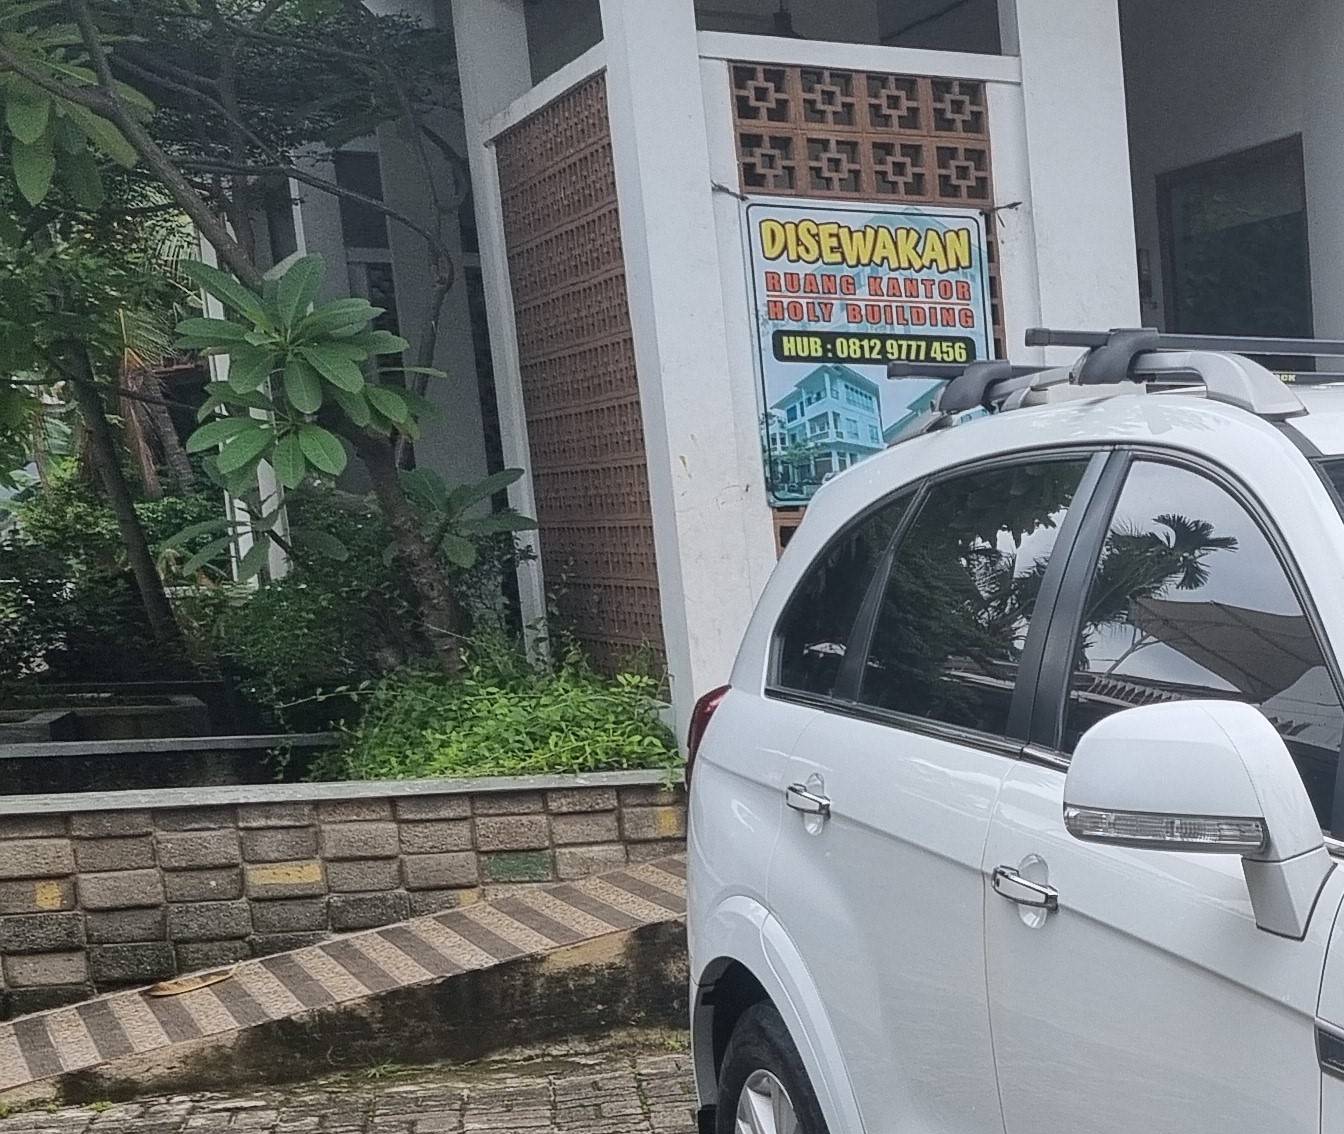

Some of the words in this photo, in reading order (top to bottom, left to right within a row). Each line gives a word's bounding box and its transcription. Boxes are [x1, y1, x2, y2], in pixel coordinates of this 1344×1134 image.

[759, 218, 973, 274] DISEWAKAN
[765, 271, 857, 296] RUANG
[867, 275, 972, 300] KANTOR
[767, 299, 834, 323] HOLY
[846, 303, 975, 329] BUILDING
[782, 335, 823, 358] HUB
[835, 337, 882, 360] 0812
[886, 339, 926, 361] 9777
[930, 341, 968, 363] 456
